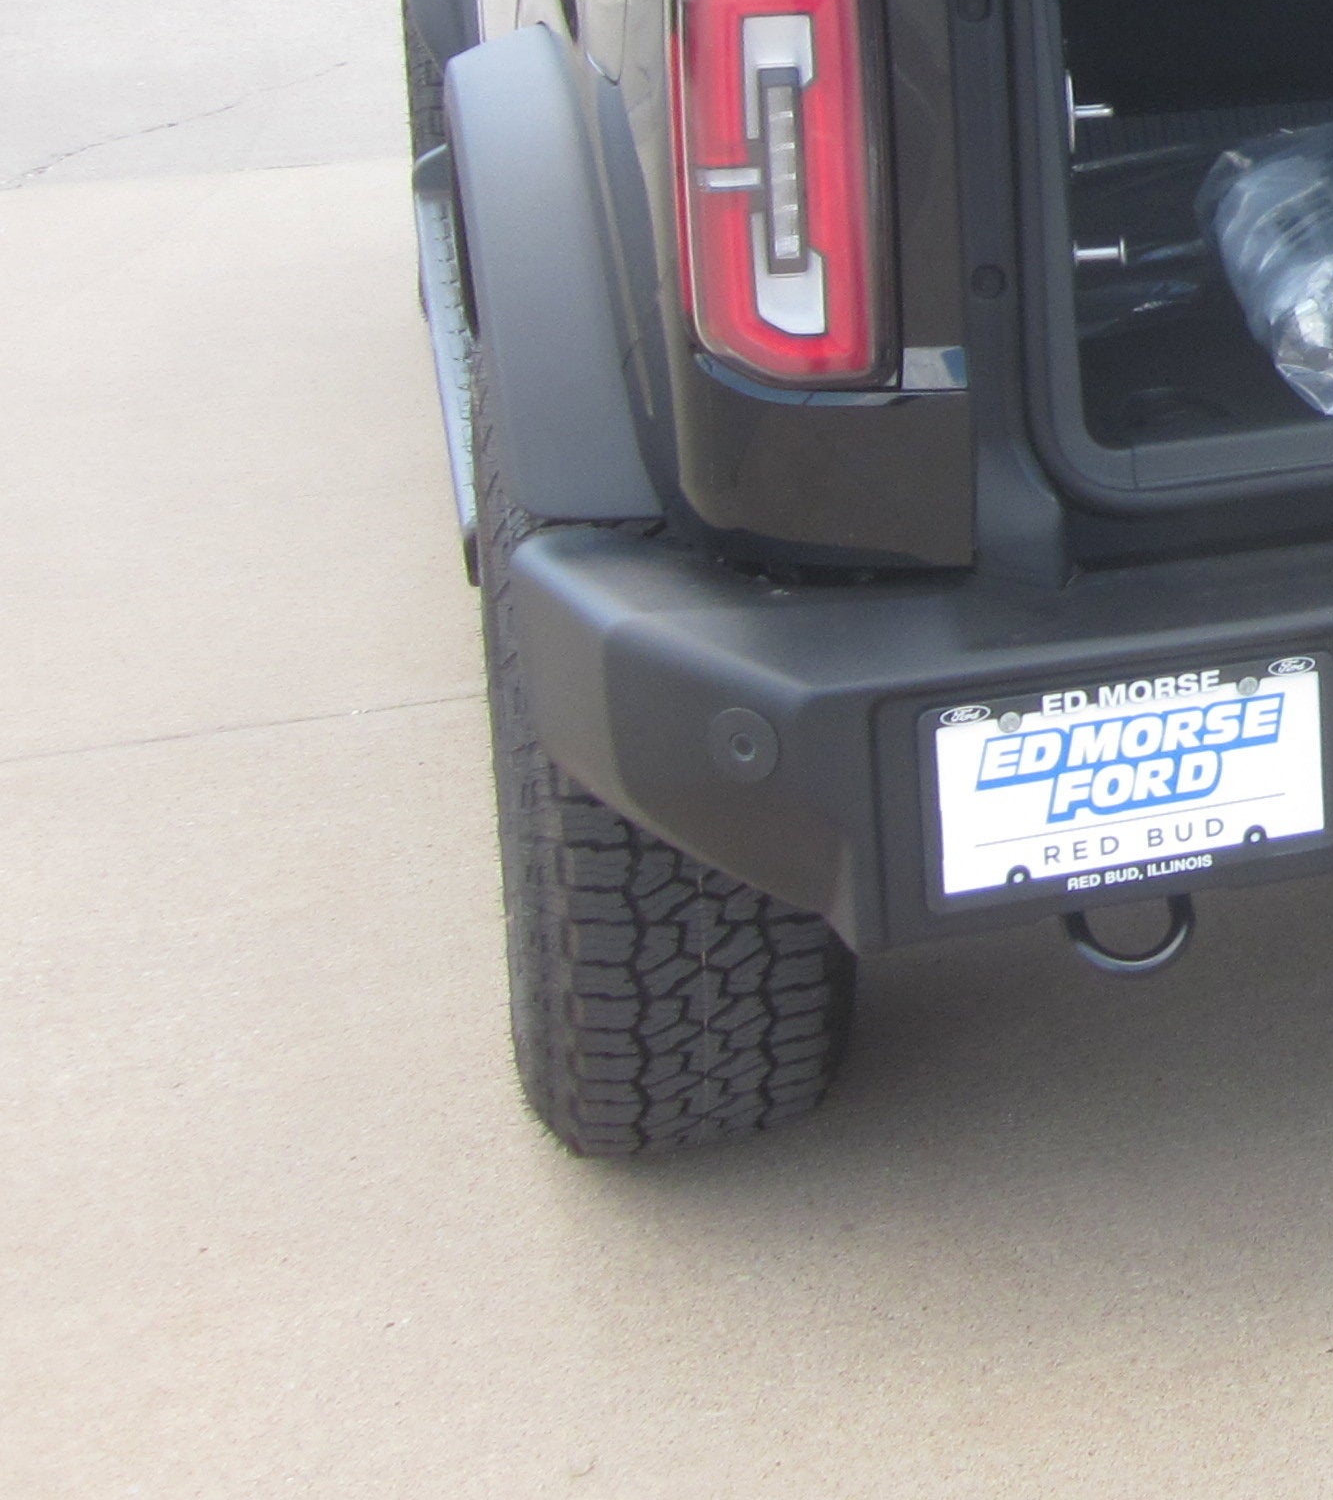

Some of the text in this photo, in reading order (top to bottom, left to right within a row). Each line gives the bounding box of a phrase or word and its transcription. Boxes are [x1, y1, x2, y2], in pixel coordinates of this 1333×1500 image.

[1275, 658, 1308, 674] Ford
[948, 707, 983, 723] Ford
[1041, 669, 1221, 717] ED MORSE
[978, 695, 1281, 782] ED MORSE
[1049, 750, 1221, 817] FORD
[1044, 817, 1225, 866] RED BUD
[1067, 853, 1214, 892] RED BUD, ILLINOIS
